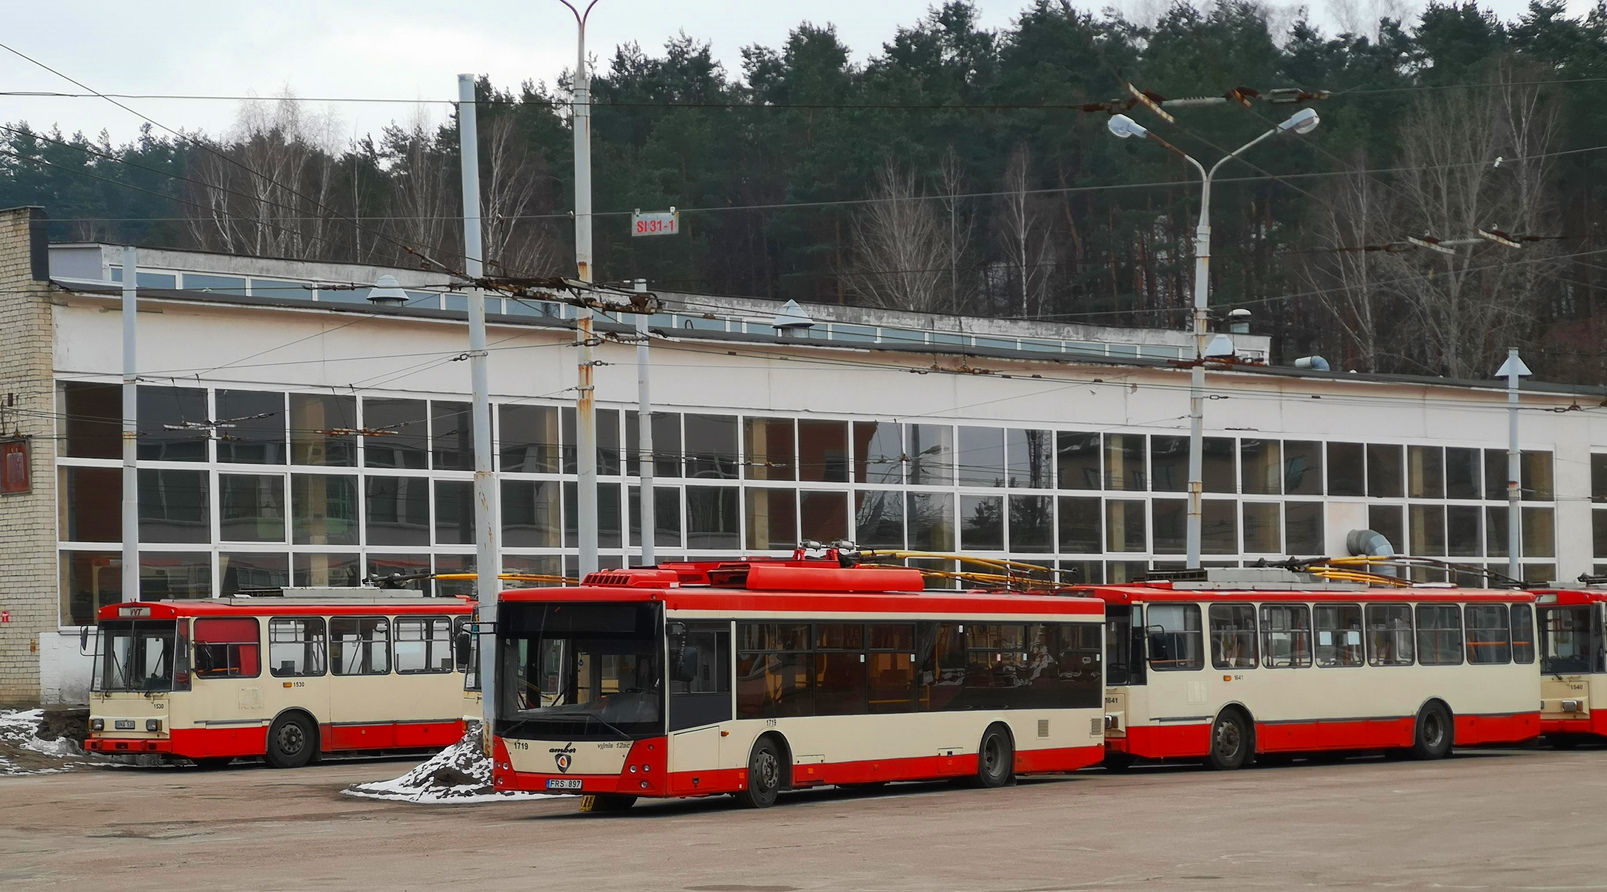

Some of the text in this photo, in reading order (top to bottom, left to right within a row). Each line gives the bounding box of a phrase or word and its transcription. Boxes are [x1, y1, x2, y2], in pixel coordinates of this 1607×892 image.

[766, 718, 777, 727] 1719
[514, 742, 529, 750] 1719
[568, 780, 581, 788] 897
